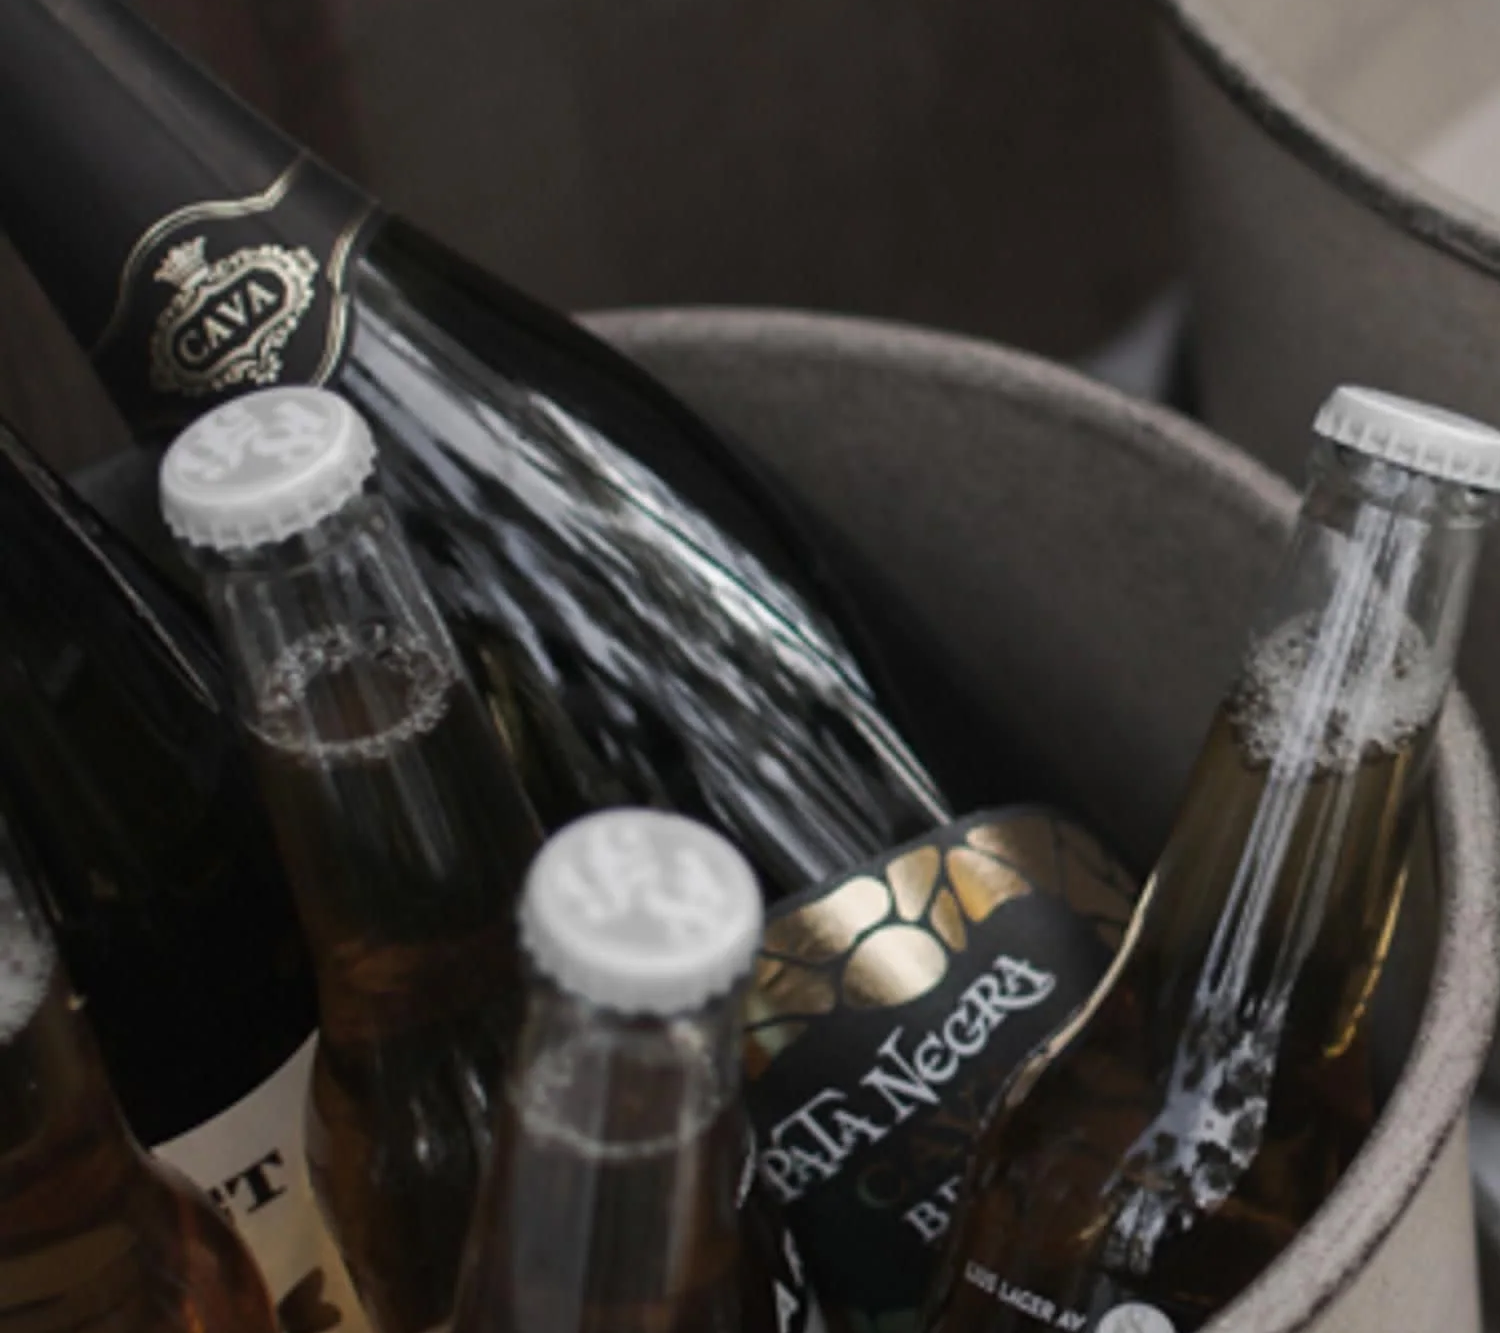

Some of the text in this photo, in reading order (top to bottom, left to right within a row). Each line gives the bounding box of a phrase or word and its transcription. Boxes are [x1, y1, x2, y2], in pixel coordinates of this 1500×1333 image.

[179, 279, 277, 364] CAVA
[760, 953, 1056, 1203] PATA NEGRA
[998, 1281, 1057, 1323] LAGER
